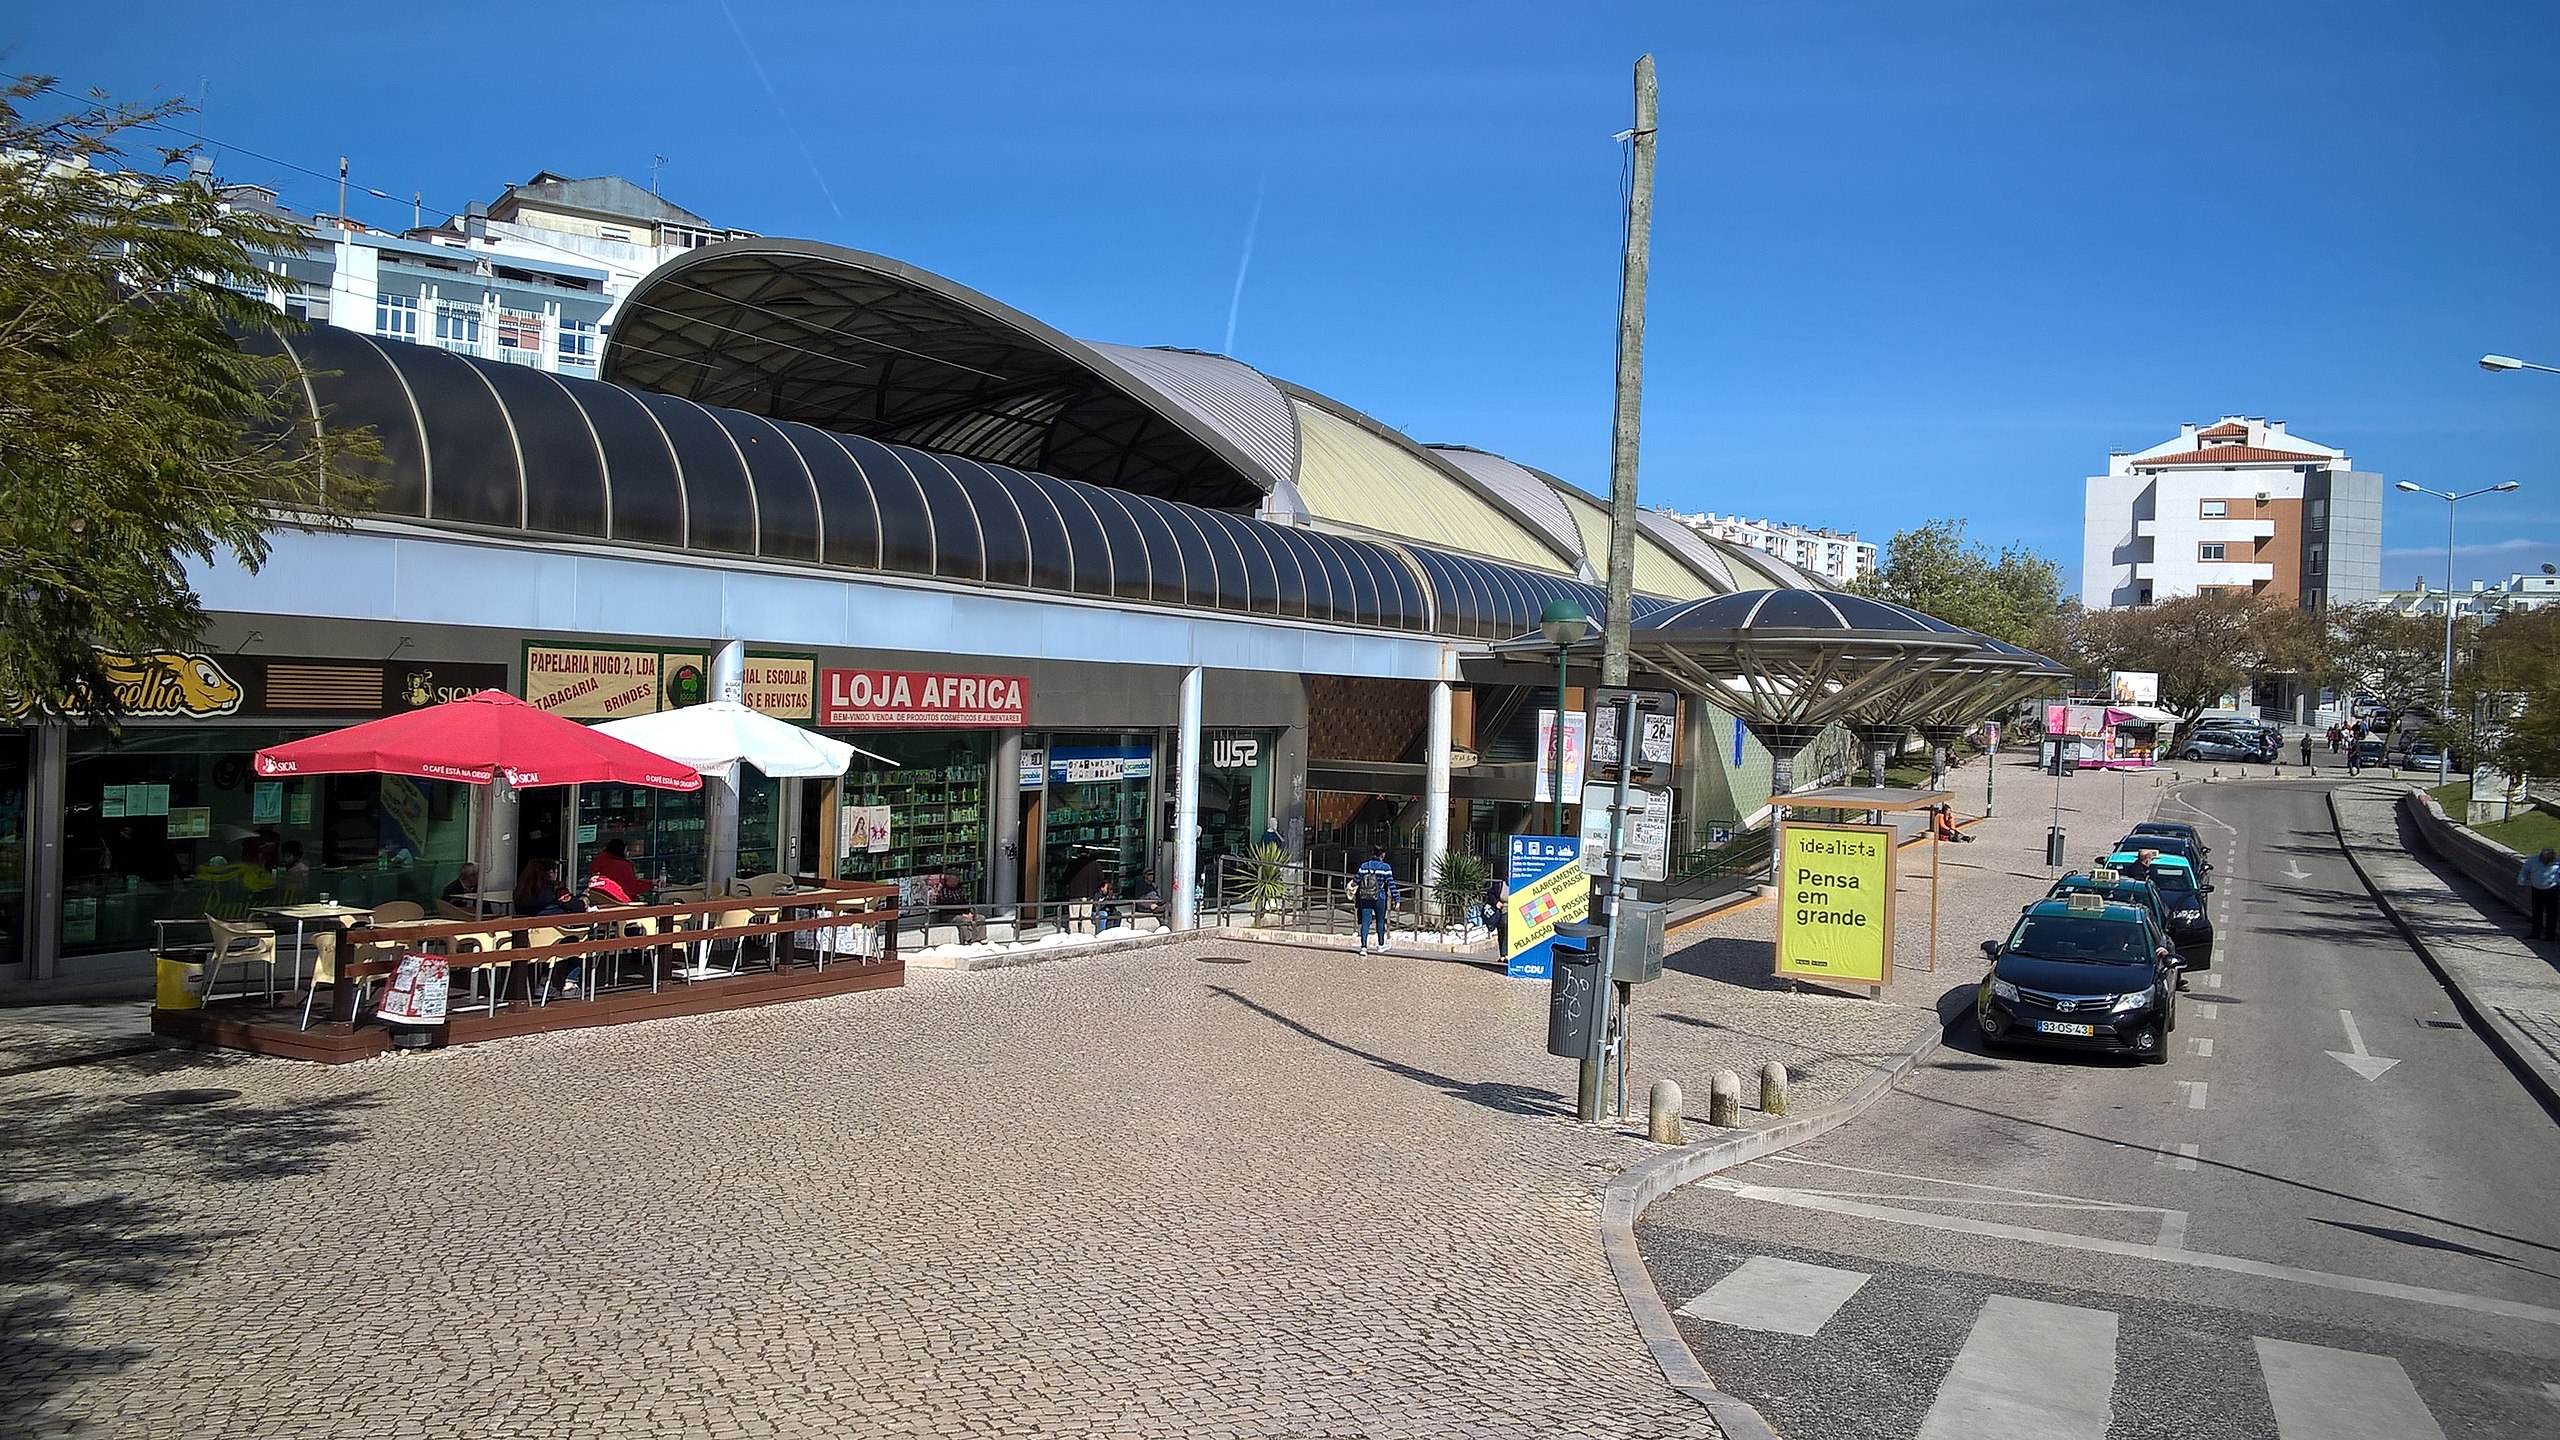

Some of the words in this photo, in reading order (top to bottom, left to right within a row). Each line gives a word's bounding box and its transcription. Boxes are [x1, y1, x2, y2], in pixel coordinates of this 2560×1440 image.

[530, 653, 589, 674] PAPELARIA
[592, 656, 621, 674] HUGO
[624, 657, 633, 678] 2,
[636, 658, 655, 676] LDA
[766, 669, 807, 684] ESCOLAR
[113, 668, 183, 710] oelho
[534, 677, 599, 711] TABACARIA
[603, 683, 651, 713] BRINDES
[831, 673, 912, 708] LOJA
[921, 677, 1023, 709] AFRICA
[756, 694, 761, 706] E
[764, 693, 808, 708] REVISTAS
[833, 713, 870, 721] BEM-VINDO
[872, 714, 894, 722] VENDA
[897, 714, 906, 722] DE
[906, 714, 940, 722] PRODUTOS
[940, 713, 977, 722] COSMÉTICOS
[978, 714, 982, 722] E
[982, 714, 1020, 722] ALIMENTARES
[278, 761, 298, 771] SICAL
[422, 764, 428, 772] O
[428, 764, 444, 774] CAFÉ
[446, 766, 460, 776] ESTÁ
[518, 772, 540, 783] SICAL
[1800, 838, 1875, 857] idealista
[1532, 864, 1580, 896] ALARGAMENTO
[1552, 885, 1563, 894] DO
[1564, 872, 1586, 889] PASSE
[1798, 868, 1860, 889] Pensa
[1562, 892, 1590, 912] POSSÍVE
[1797, 890, 1828, 906] em
[1796, 910, 1866, 926] grande
[1514, 937, 1532, 950] PELA
[1530, 924, 1552, 938] ACÇÃO
[1573, 908, 1584, 918] DA
[1524, 964, 1544, 974] CDU
